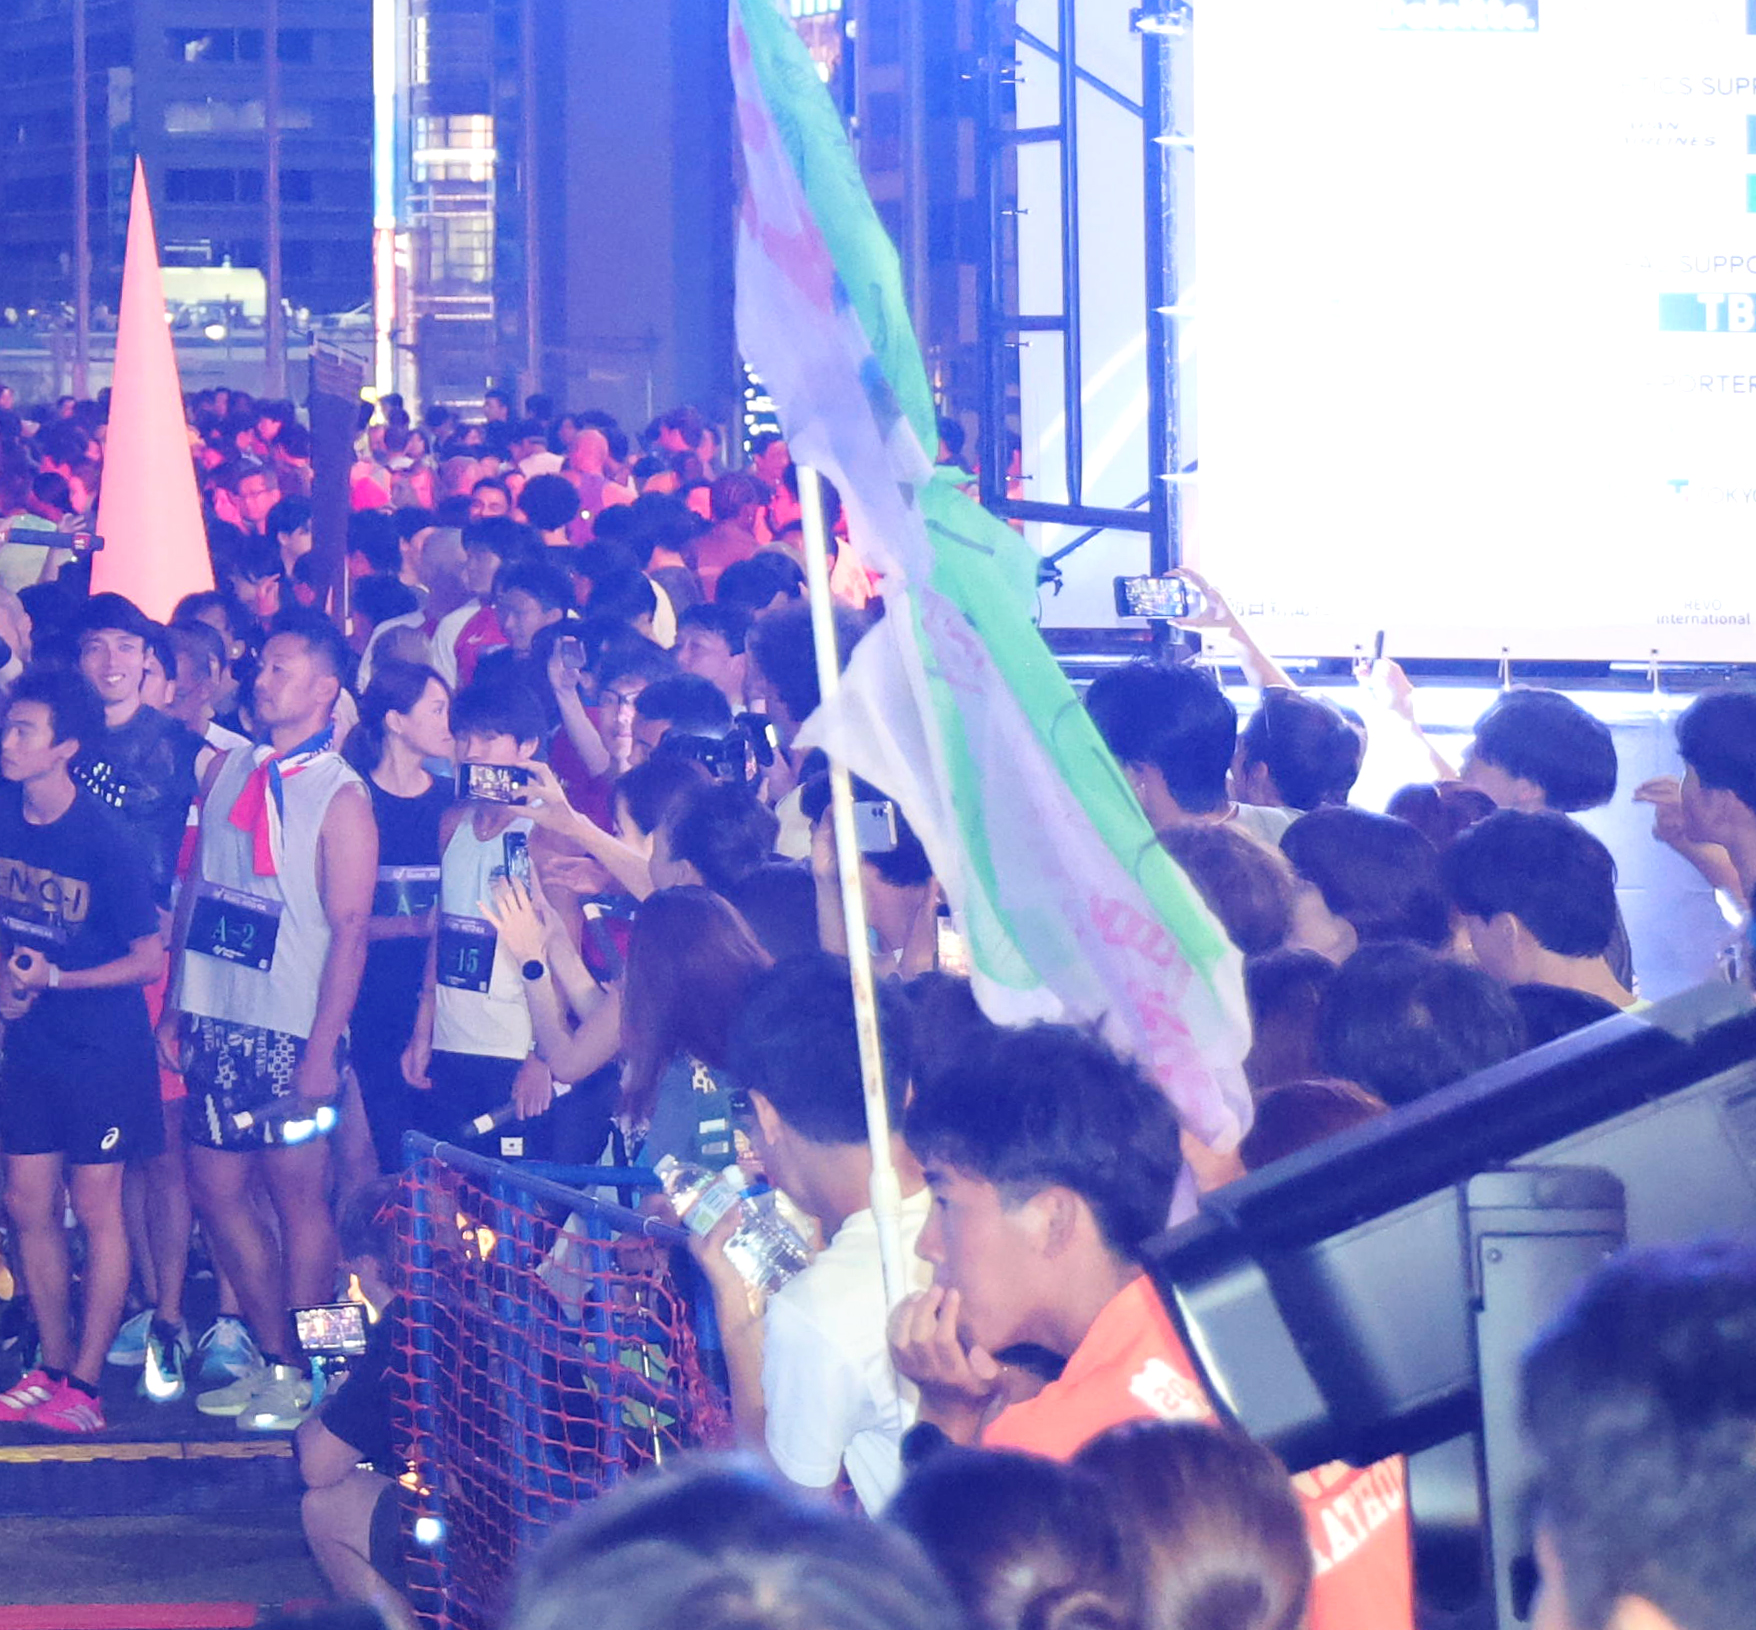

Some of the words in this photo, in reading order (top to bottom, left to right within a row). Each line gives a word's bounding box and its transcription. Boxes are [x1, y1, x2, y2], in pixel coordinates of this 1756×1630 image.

[1696, 292, 1755, 332] TB
[1655, 611, 1752, 626] international
[211, 915, 255, 949] A-2
